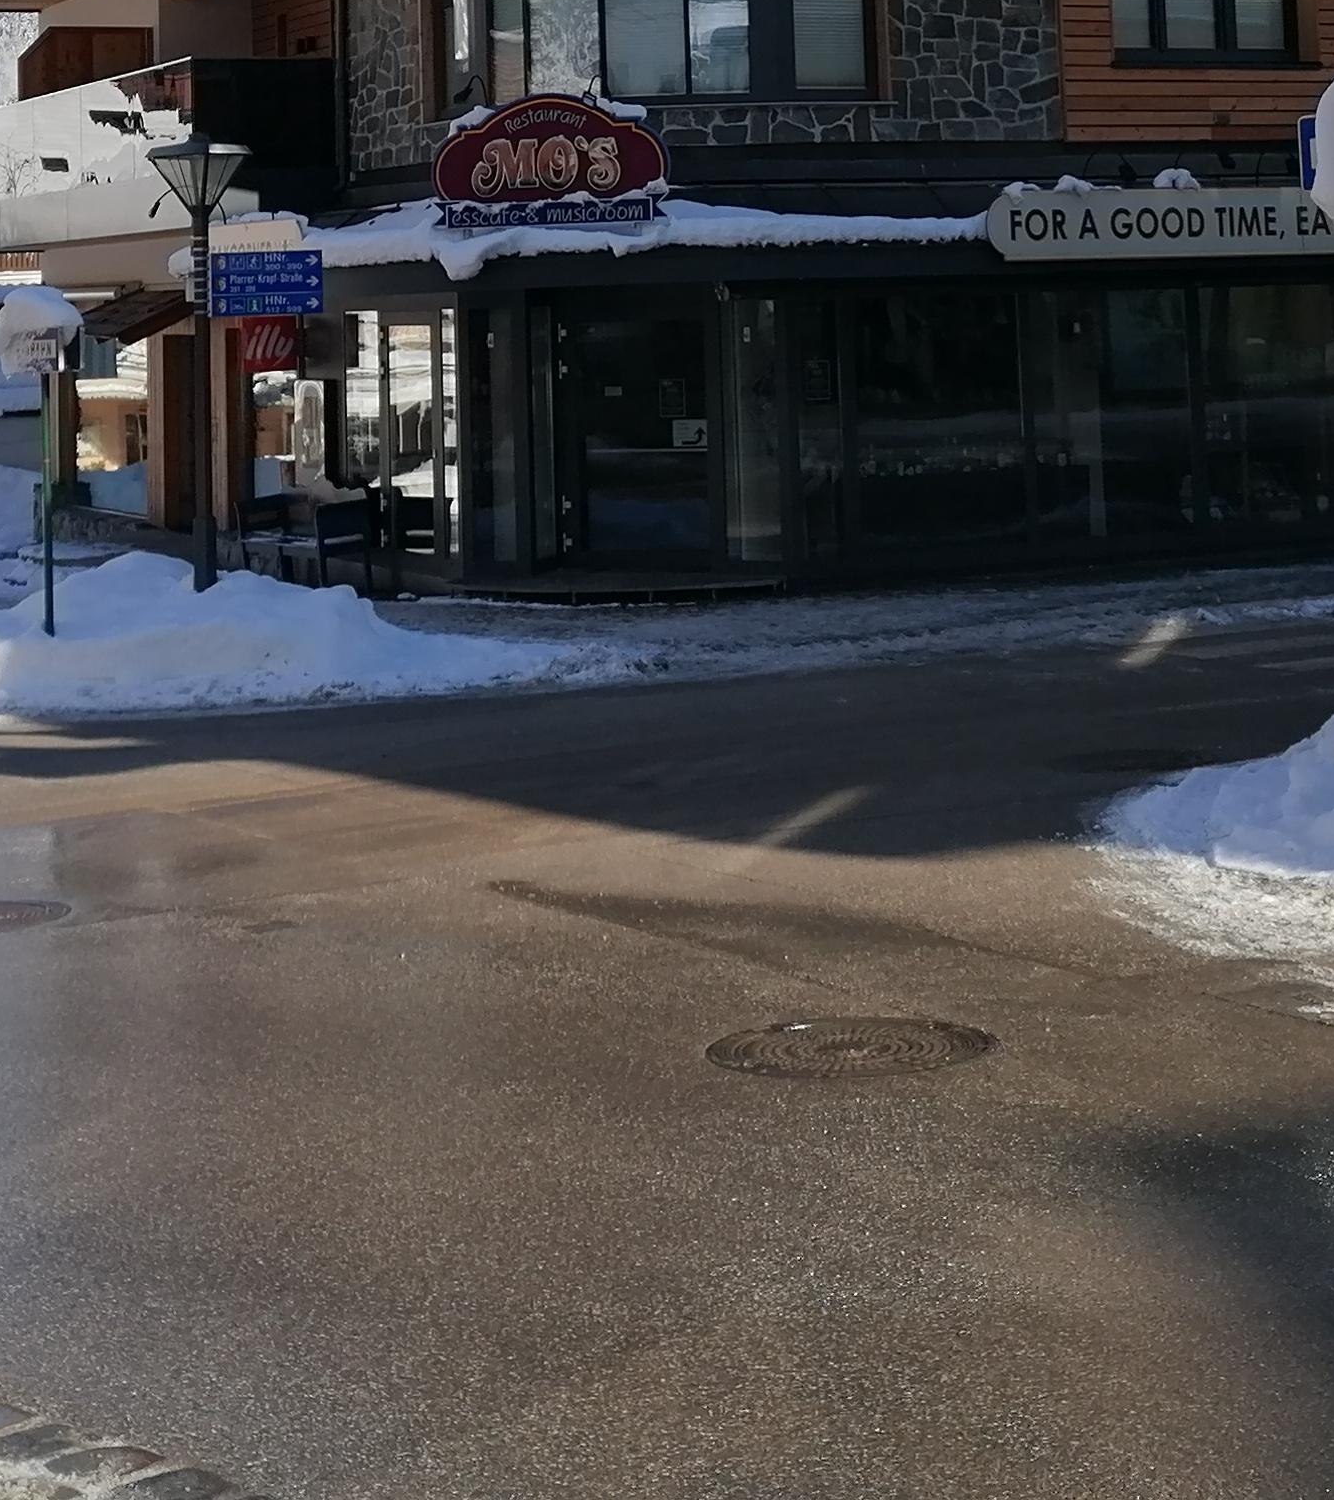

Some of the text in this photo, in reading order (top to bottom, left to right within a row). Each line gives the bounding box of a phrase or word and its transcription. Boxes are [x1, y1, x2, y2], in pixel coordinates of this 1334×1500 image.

[504, 108, 587, 134] Restaurant
[546, 204, 644, 223] musicroom
[1009, 208, 1067, 241] FOR
[1078, 208, 1100, 240] A
[1110, 206, 1205, 240] GOOD
[1214, 205, 1285, 240] TIME,
[245, 323, 294, 367] illy
